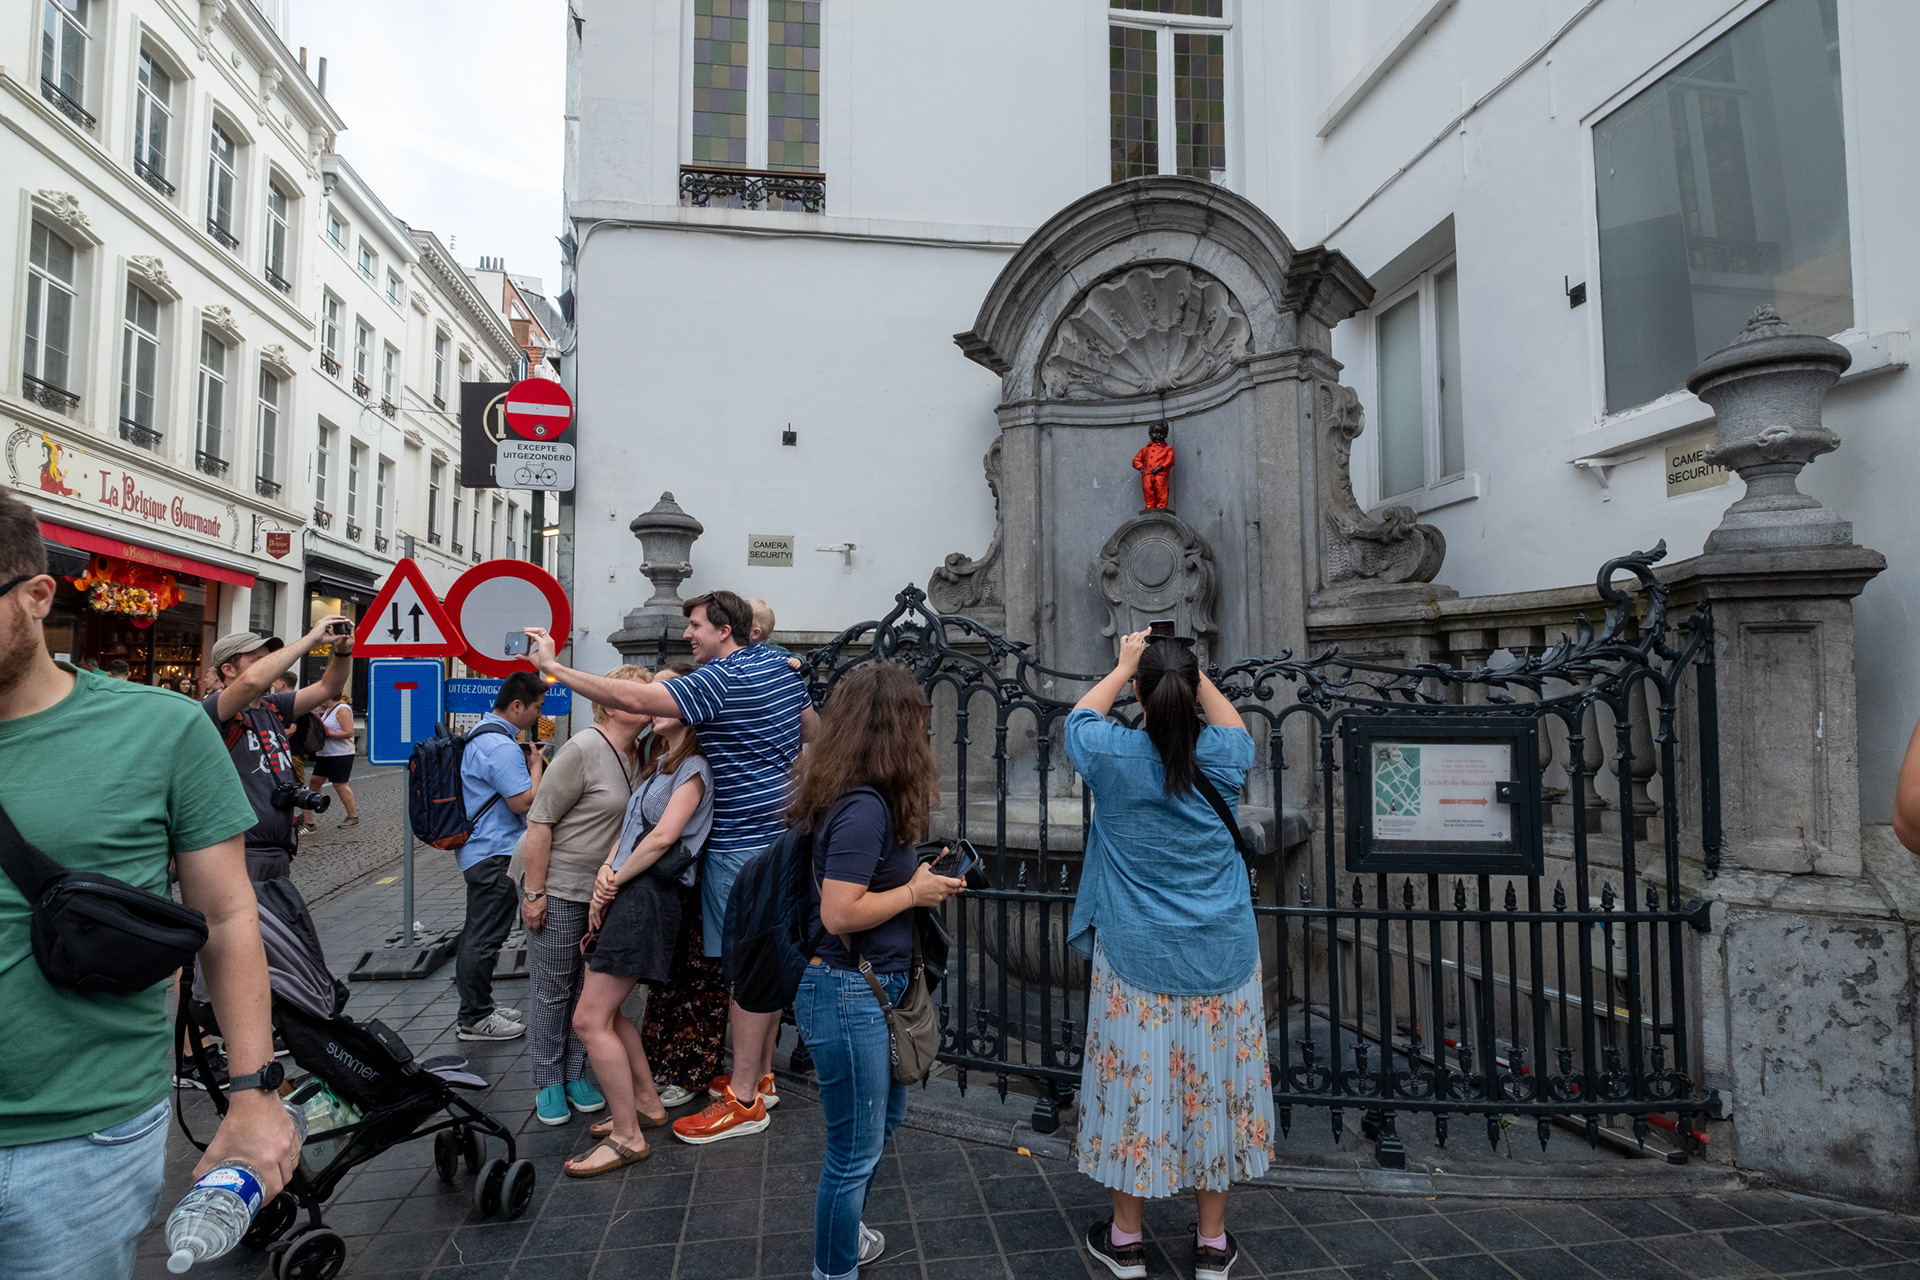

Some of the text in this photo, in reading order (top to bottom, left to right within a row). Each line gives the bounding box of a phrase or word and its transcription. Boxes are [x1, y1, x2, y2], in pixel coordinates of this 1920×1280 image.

[517, 443, 557, 452] EXCEPTE
[503, 452, 572, 462] UITGEZONDERD
[1672, 450, 1704, 468] CAME
[99, 469, 221, 538] La Belgique Gourmande
[753, 541, 788, 549] CAMERA
[326, 1041, 380, 1081] summer
